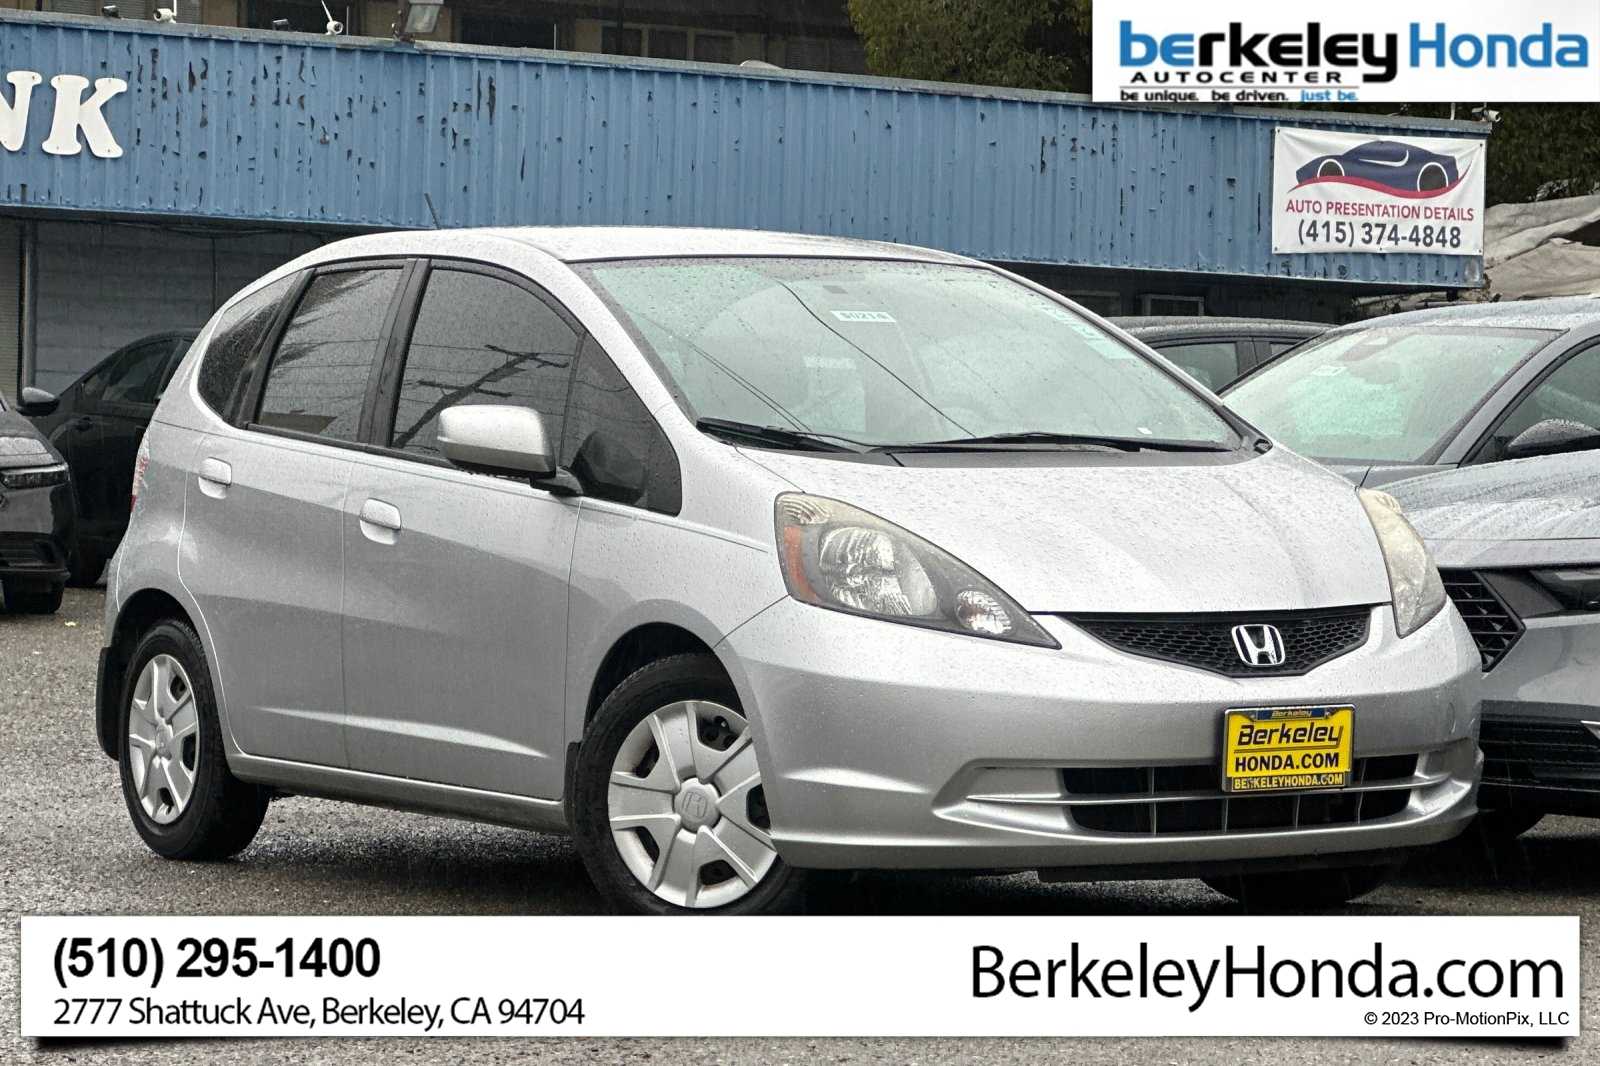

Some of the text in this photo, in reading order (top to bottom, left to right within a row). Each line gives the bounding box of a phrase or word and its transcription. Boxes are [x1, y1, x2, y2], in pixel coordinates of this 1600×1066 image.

[1286, 199, 1474, 221] AUTO PRESENTATION DETAILS
[1298, 219, 1462, 249] (415) 374-4848
[1271, 710, 1313, 719] Berkeley
[1237, 721, 1344, 747] Berkeley
[1235, 752, 1340, 773] HONDA.COM
